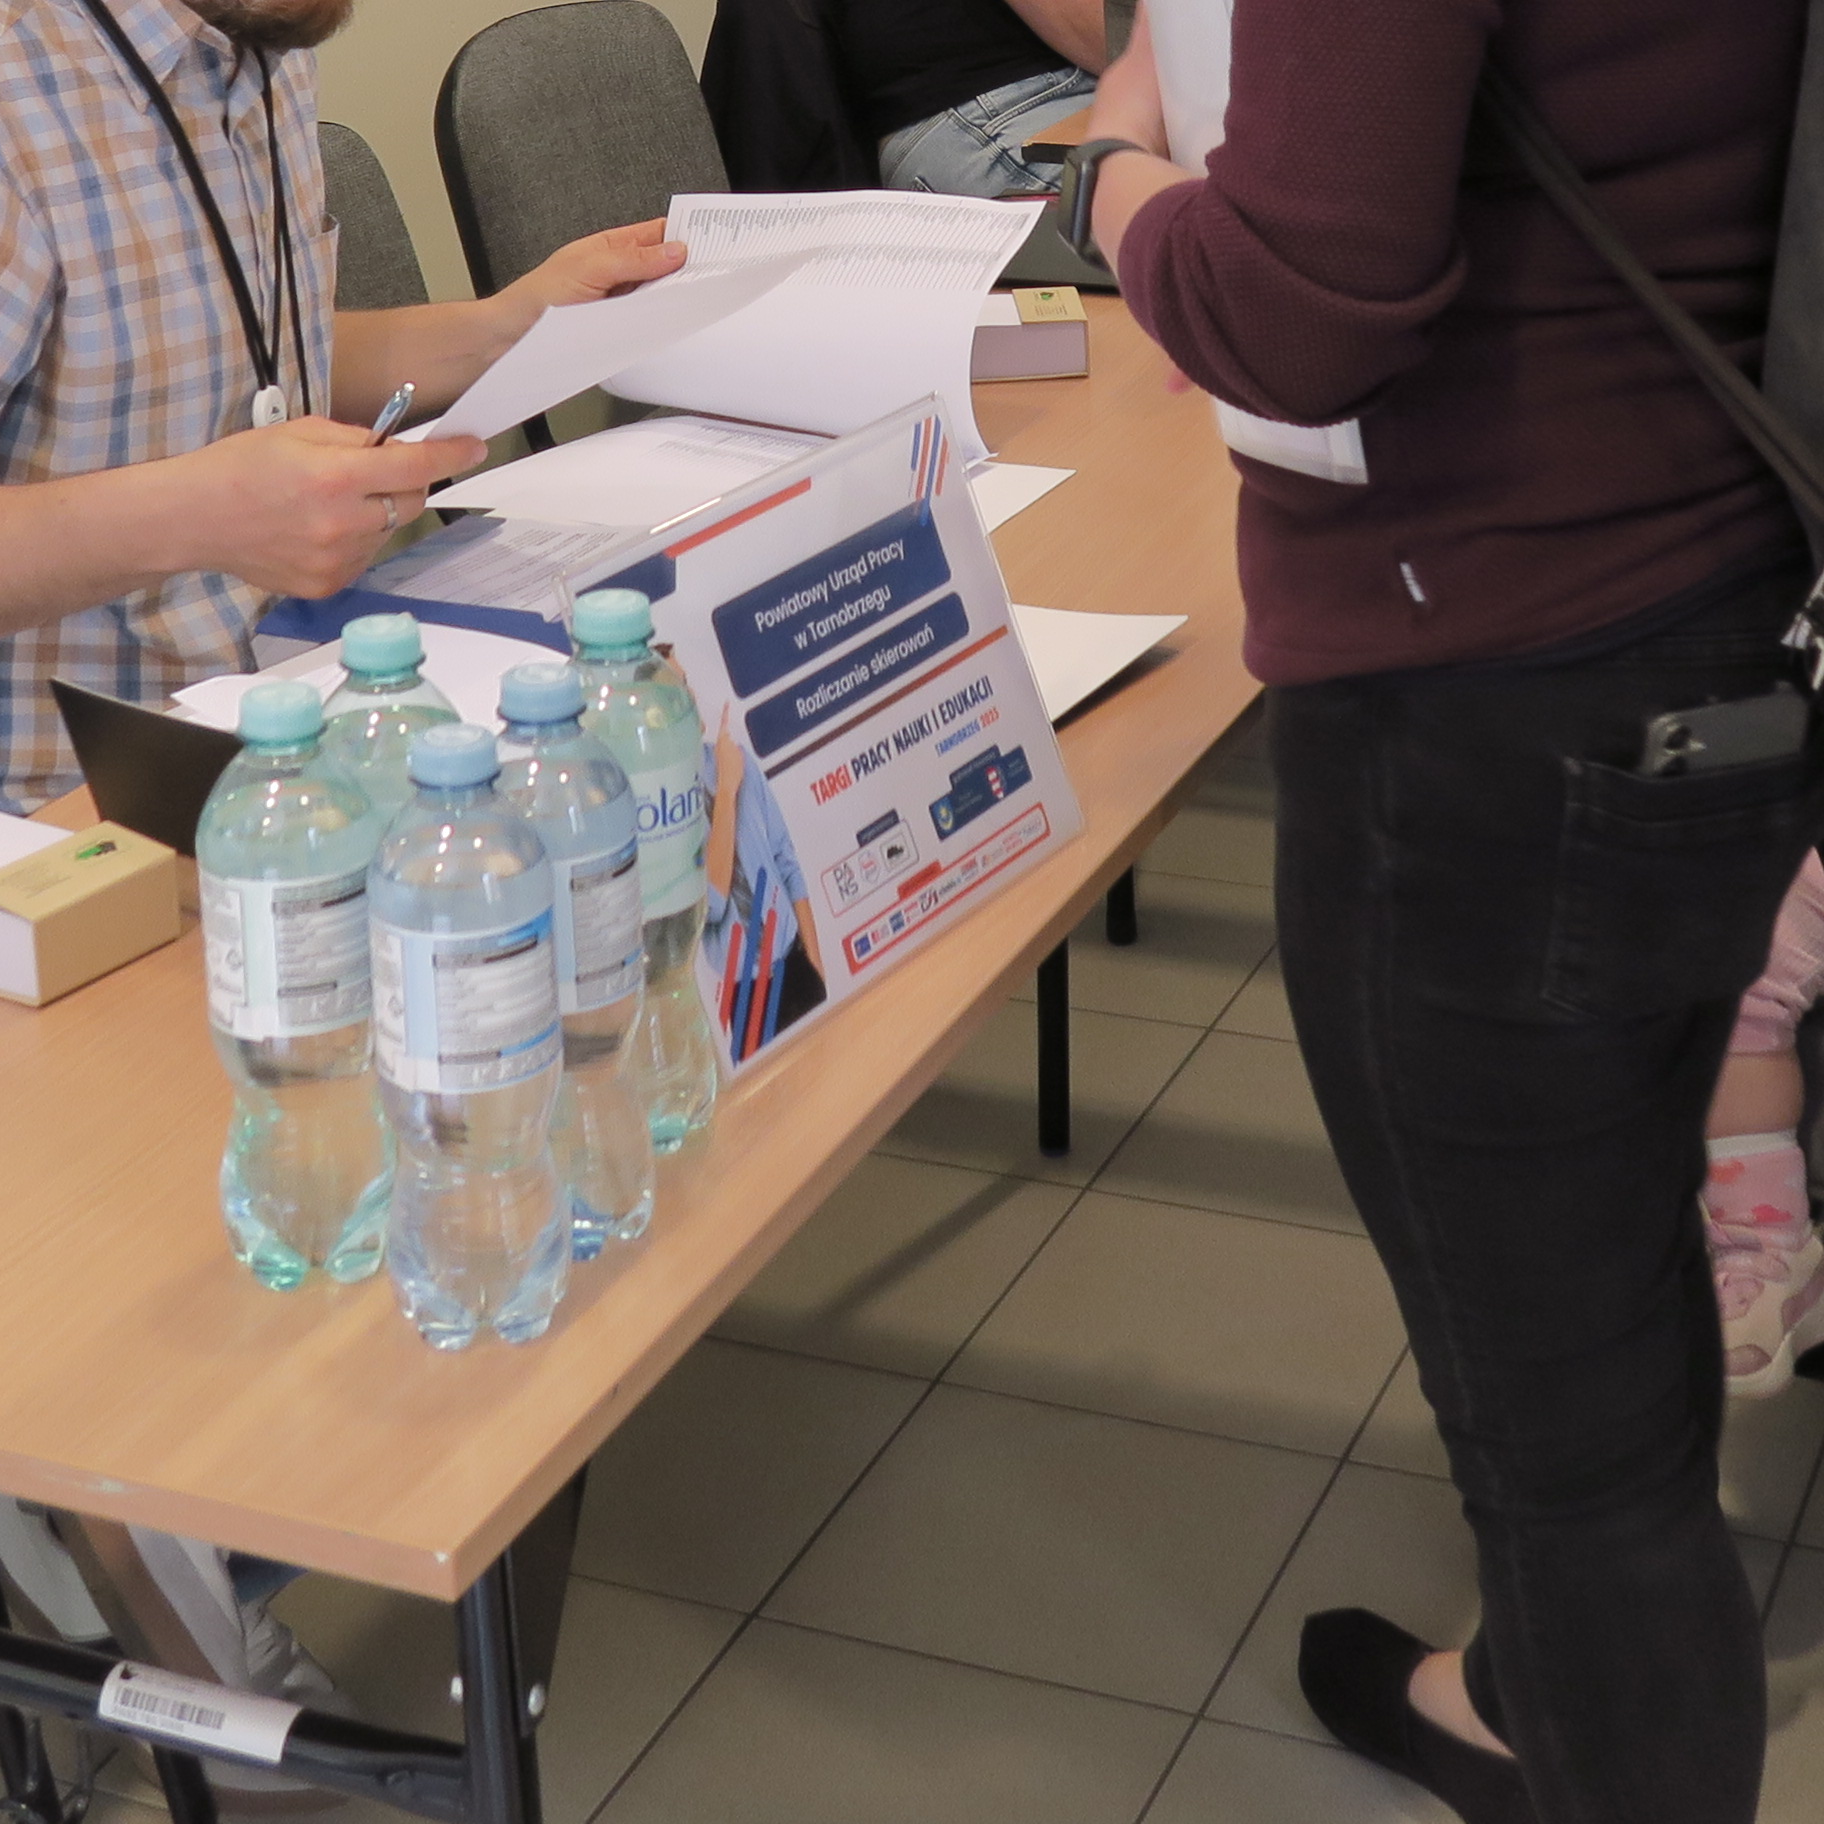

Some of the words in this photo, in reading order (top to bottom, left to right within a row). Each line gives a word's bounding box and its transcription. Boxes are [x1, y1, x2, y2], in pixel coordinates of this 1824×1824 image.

[753, 579, 830, 633] Powiatowy
[828, 554, 868, 592] Urząd
[869, 538, 905, 571] Pracy
[793, 631, 809, 651] w
[806, 584, 893, 643] Tarnobrzegu
[795, 662, 870, 719] Rozliczanie
[869, 623, 936, 676] skierowań
[810, 763, 853, 806] TARGI
[850, 738, 892, 783] PRACY
[892, 711, 933, 756] NAUKI
[931, 707, 940, 730] I
[938, 675, 994, 726] EDUKACJI
